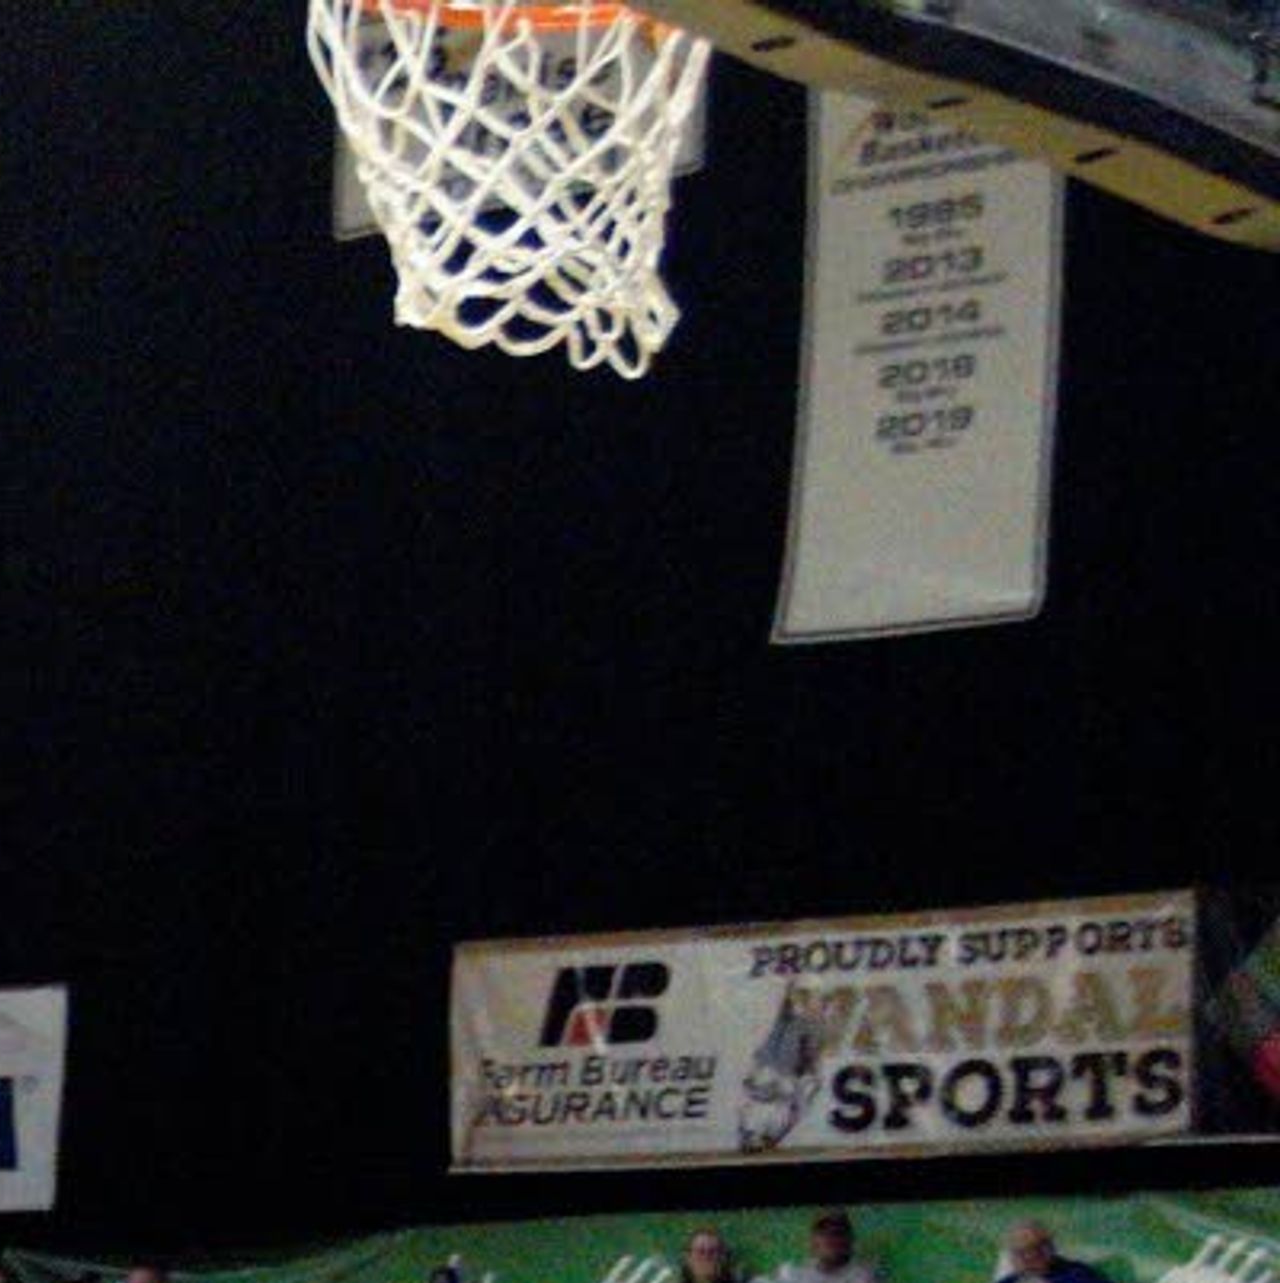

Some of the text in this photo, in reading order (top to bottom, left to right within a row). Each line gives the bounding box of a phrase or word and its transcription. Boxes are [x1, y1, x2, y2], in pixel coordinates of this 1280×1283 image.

[750, 915, 1186, 978] PROUDLY SUPPORTS
[580, 1055, 717, 1087] Bureau
[828, 1046, 1186, 1134] SPORTS
